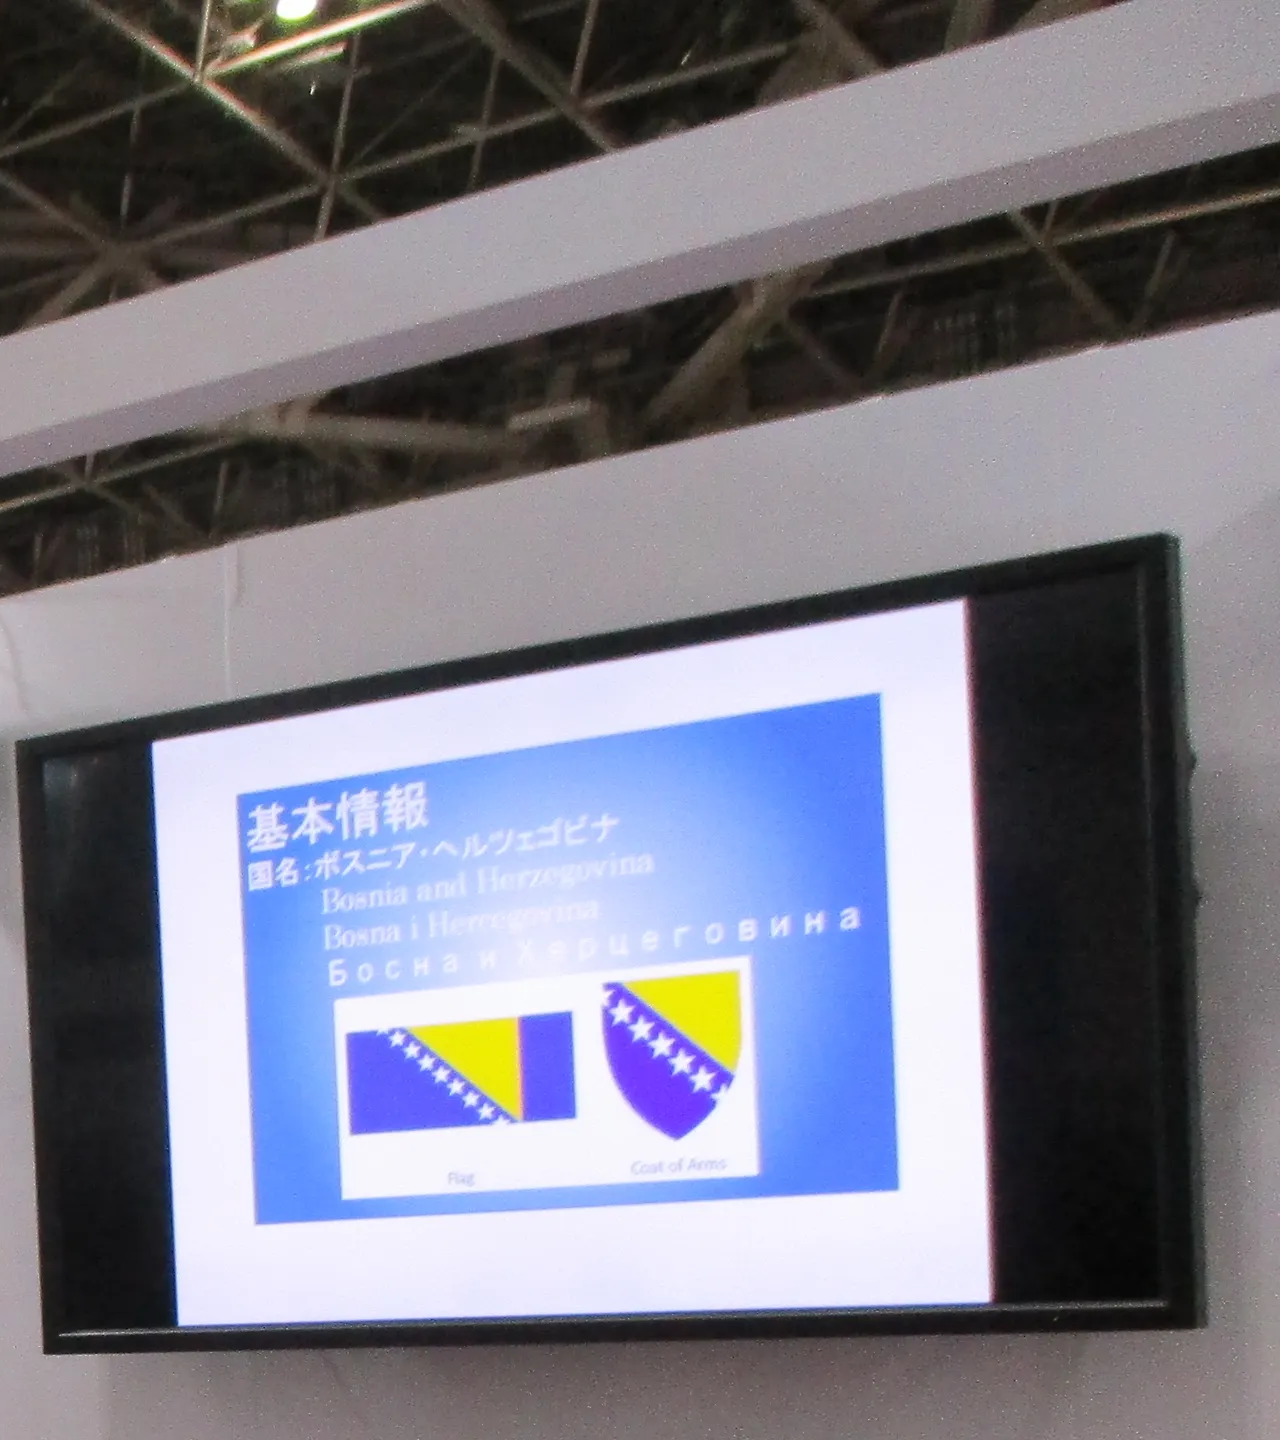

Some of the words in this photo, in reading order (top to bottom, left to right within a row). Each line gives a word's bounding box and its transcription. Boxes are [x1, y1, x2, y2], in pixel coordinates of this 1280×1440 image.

[246, 781, 429, 853] 基本情報
[321, 881, 408, 914] Bosnia
[416, 871, 466, 901] and
[476, 852, 654, 895] Herzegovina
[323, 923, 401, 951] Bosna
[327, 950, 458, 987] Босна
[447, 1172, 476, 1187] Flag
[630, 1160, 663, 1175] Coat
[667, 1158, 684, 1173] of
[687, 1157, 728, 1172] Arms
